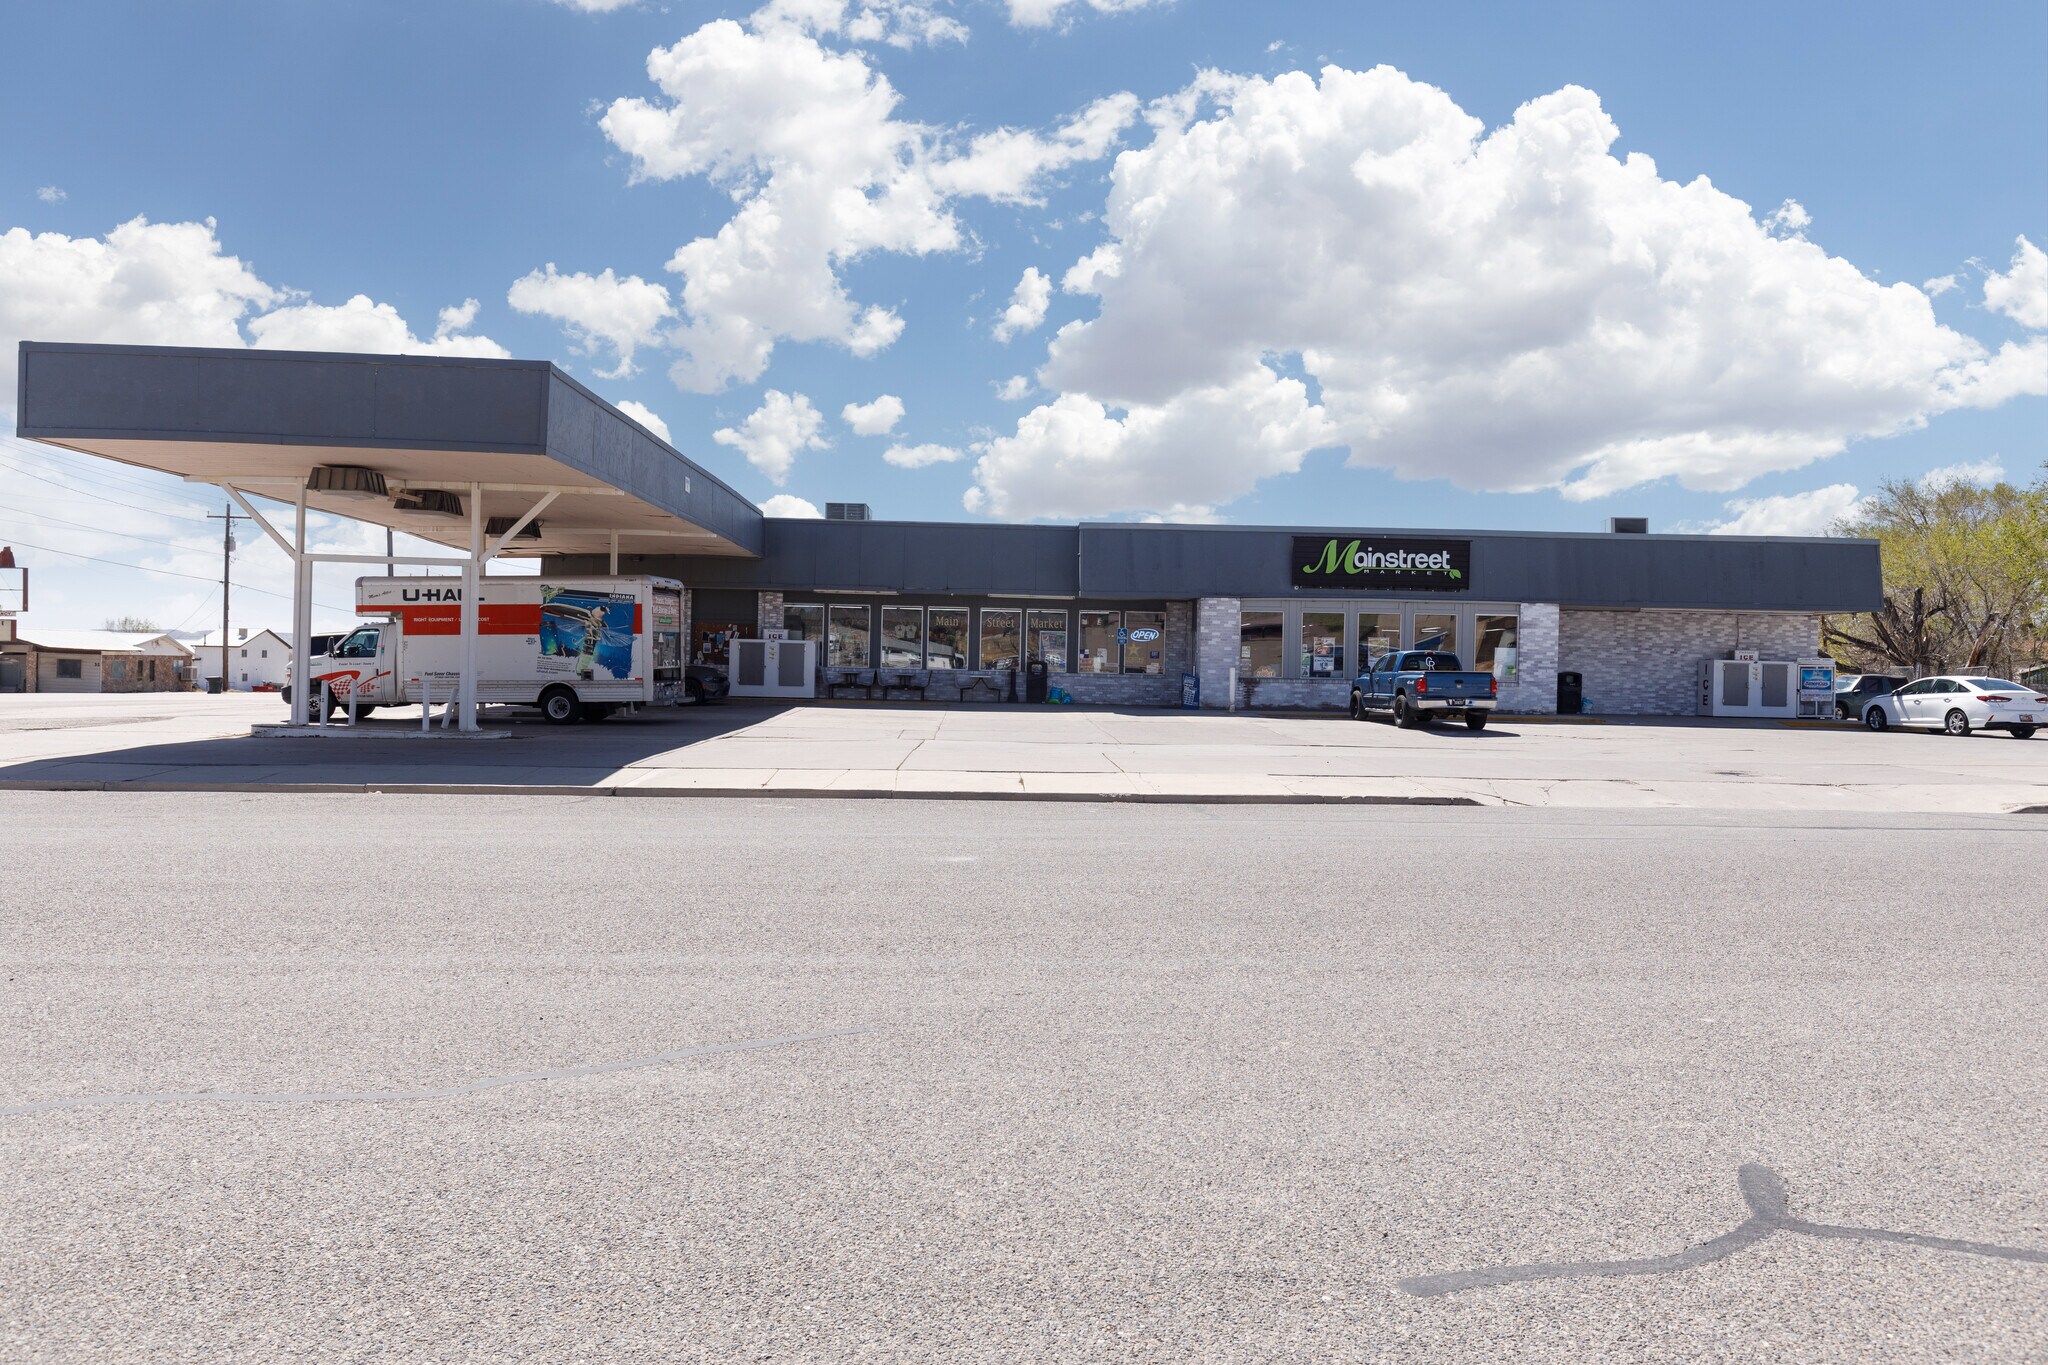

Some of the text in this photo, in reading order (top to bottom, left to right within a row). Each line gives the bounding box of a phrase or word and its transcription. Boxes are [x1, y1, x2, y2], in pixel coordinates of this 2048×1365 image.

[1302, 539, 1451, 574] Mainstreet
[402, 589, 485, 601] U-HA
[936, 616, 1063, 628] Main Street Market
[1132, 630, 1156, 640] OPEN
